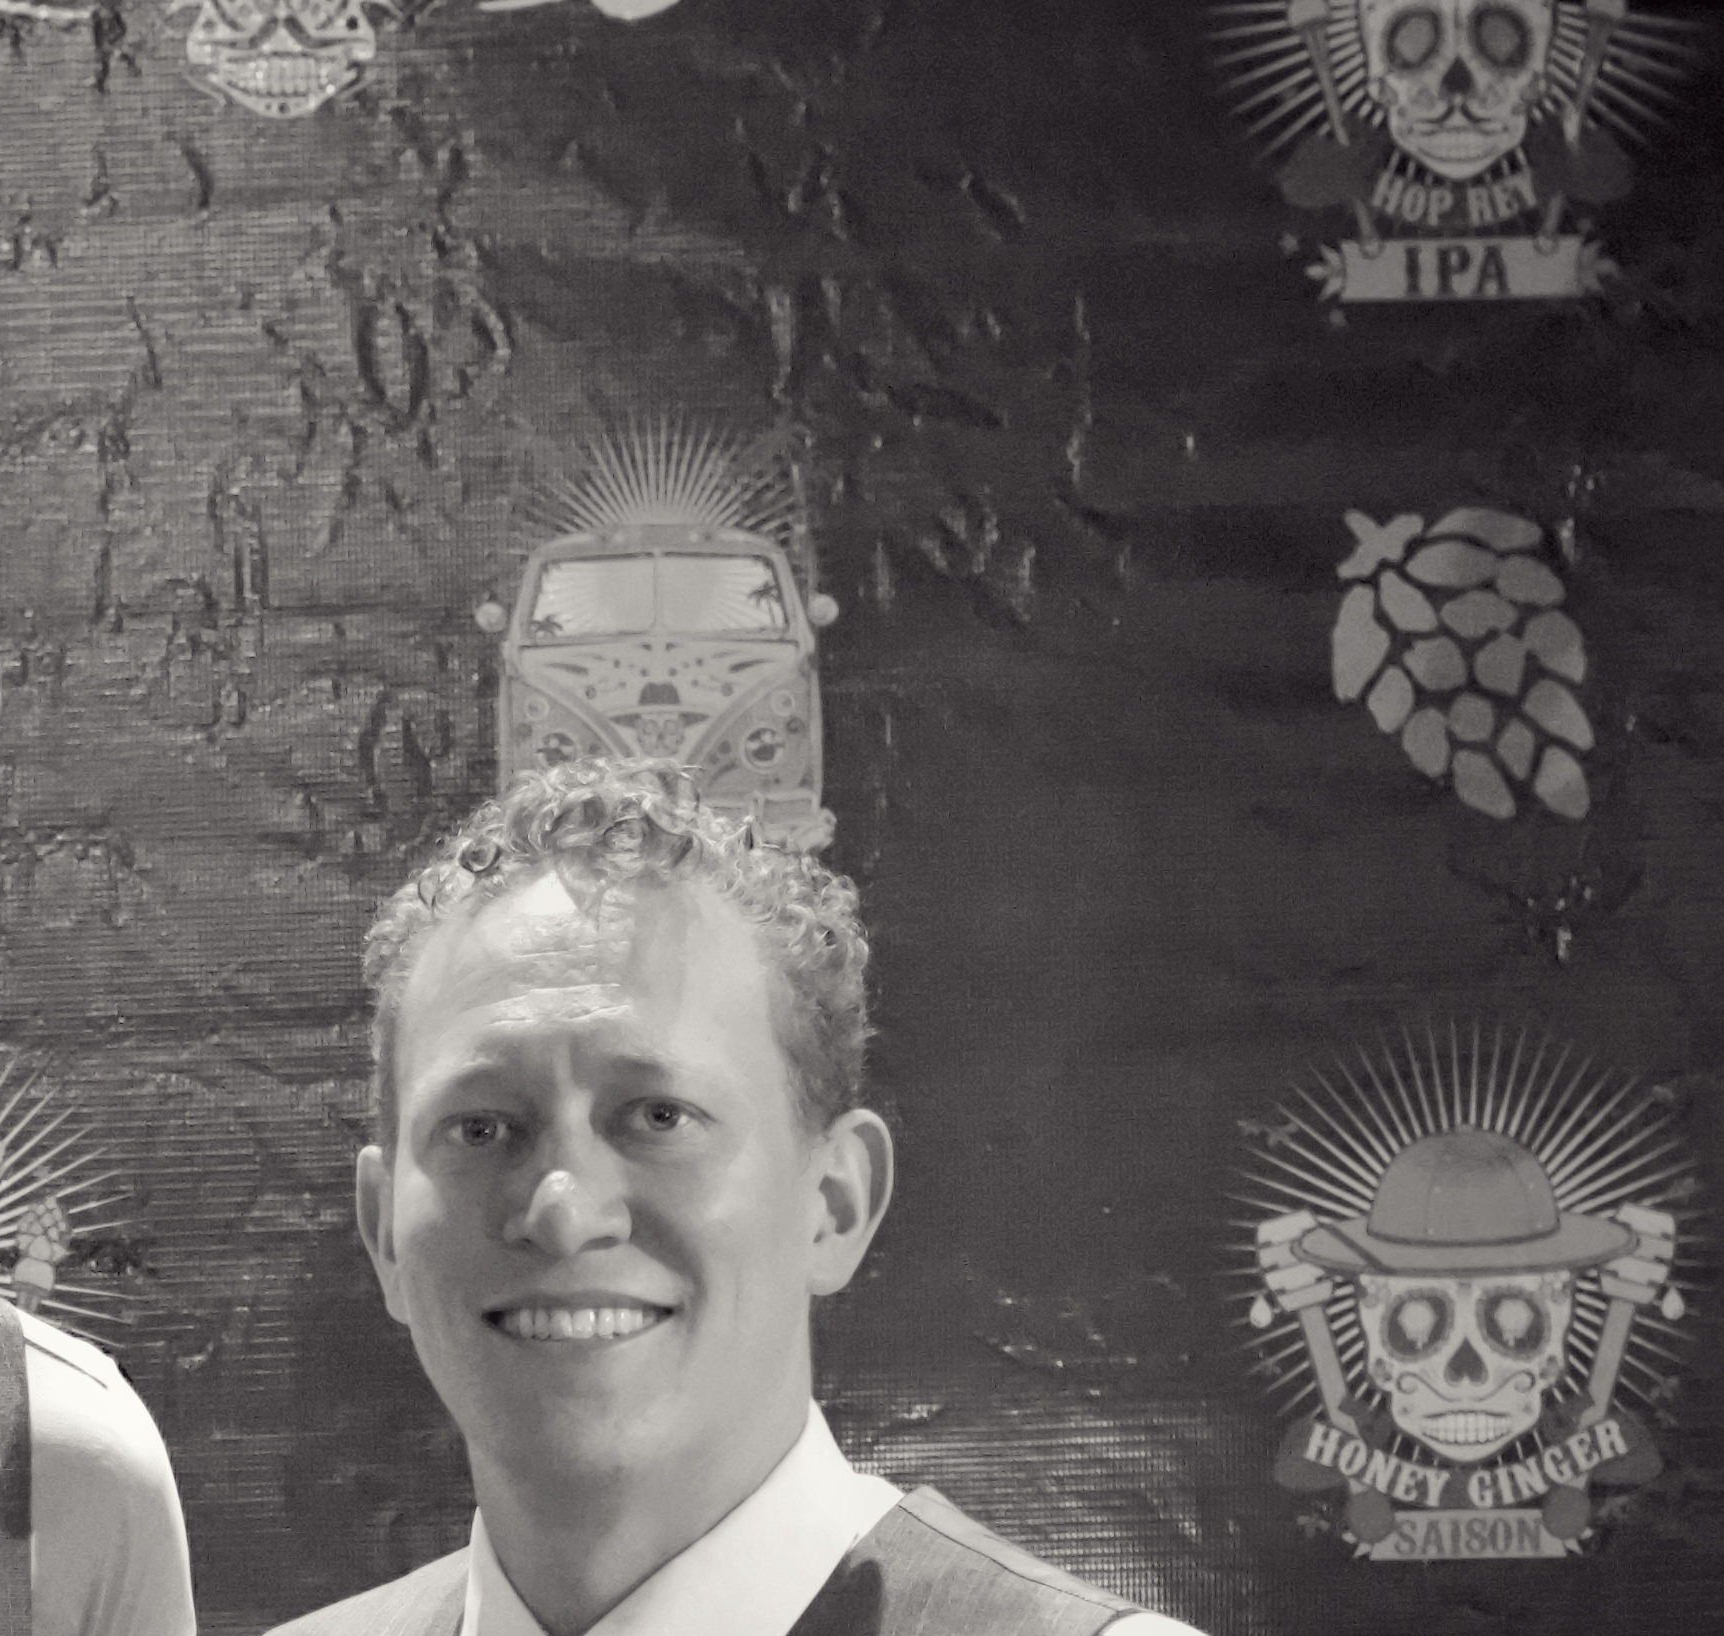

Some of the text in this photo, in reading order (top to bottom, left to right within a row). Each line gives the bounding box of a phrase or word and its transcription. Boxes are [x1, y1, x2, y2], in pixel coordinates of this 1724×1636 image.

[1372, 169, 1454, 227] HOP
[1404, 245, 1512, 297] IPA
[1304, 1418, 1628, 1508] HONEY GINGER
[1393, 1517, 1546, 1555] SAISON
